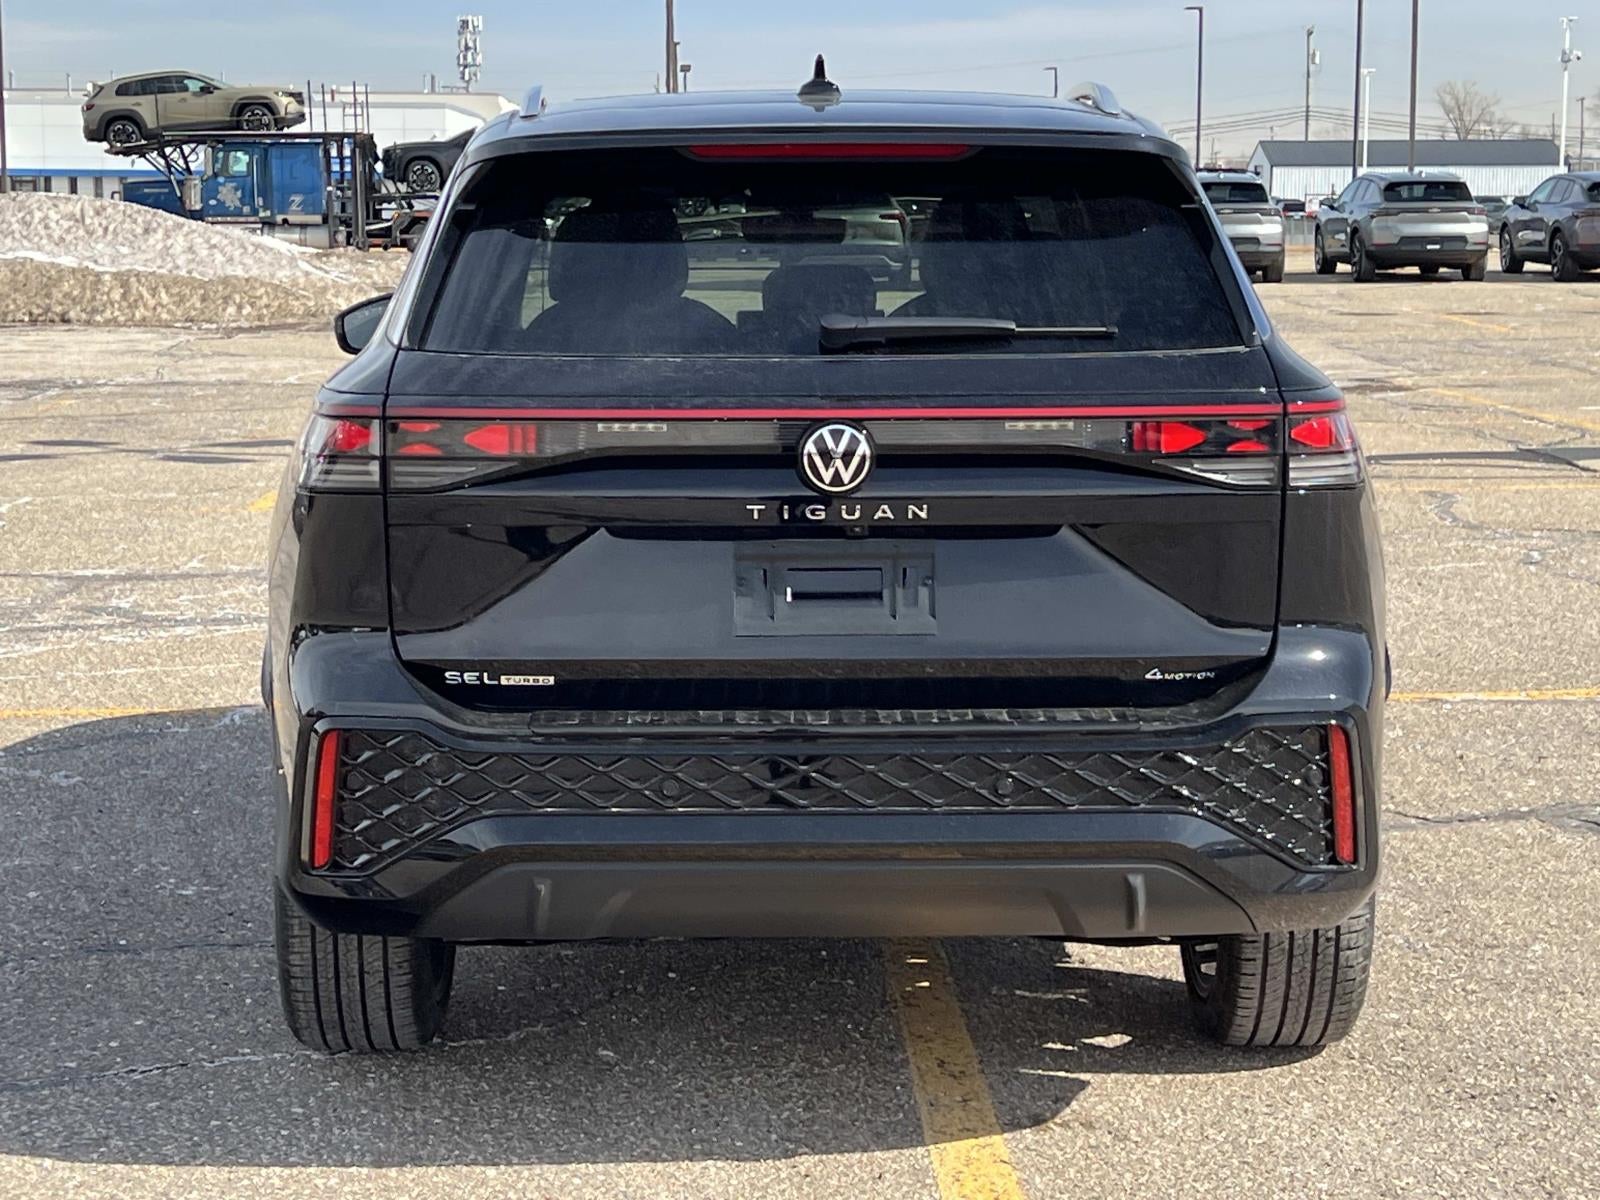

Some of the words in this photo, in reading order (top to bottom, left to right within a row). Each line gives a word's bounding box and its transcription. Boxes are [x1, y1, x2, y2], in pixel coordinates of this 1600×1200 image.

[804, 425, 871, 492] VW
[746, 504, 929, 520] TIGUAN
[444, 671, 499, 684] SEL
